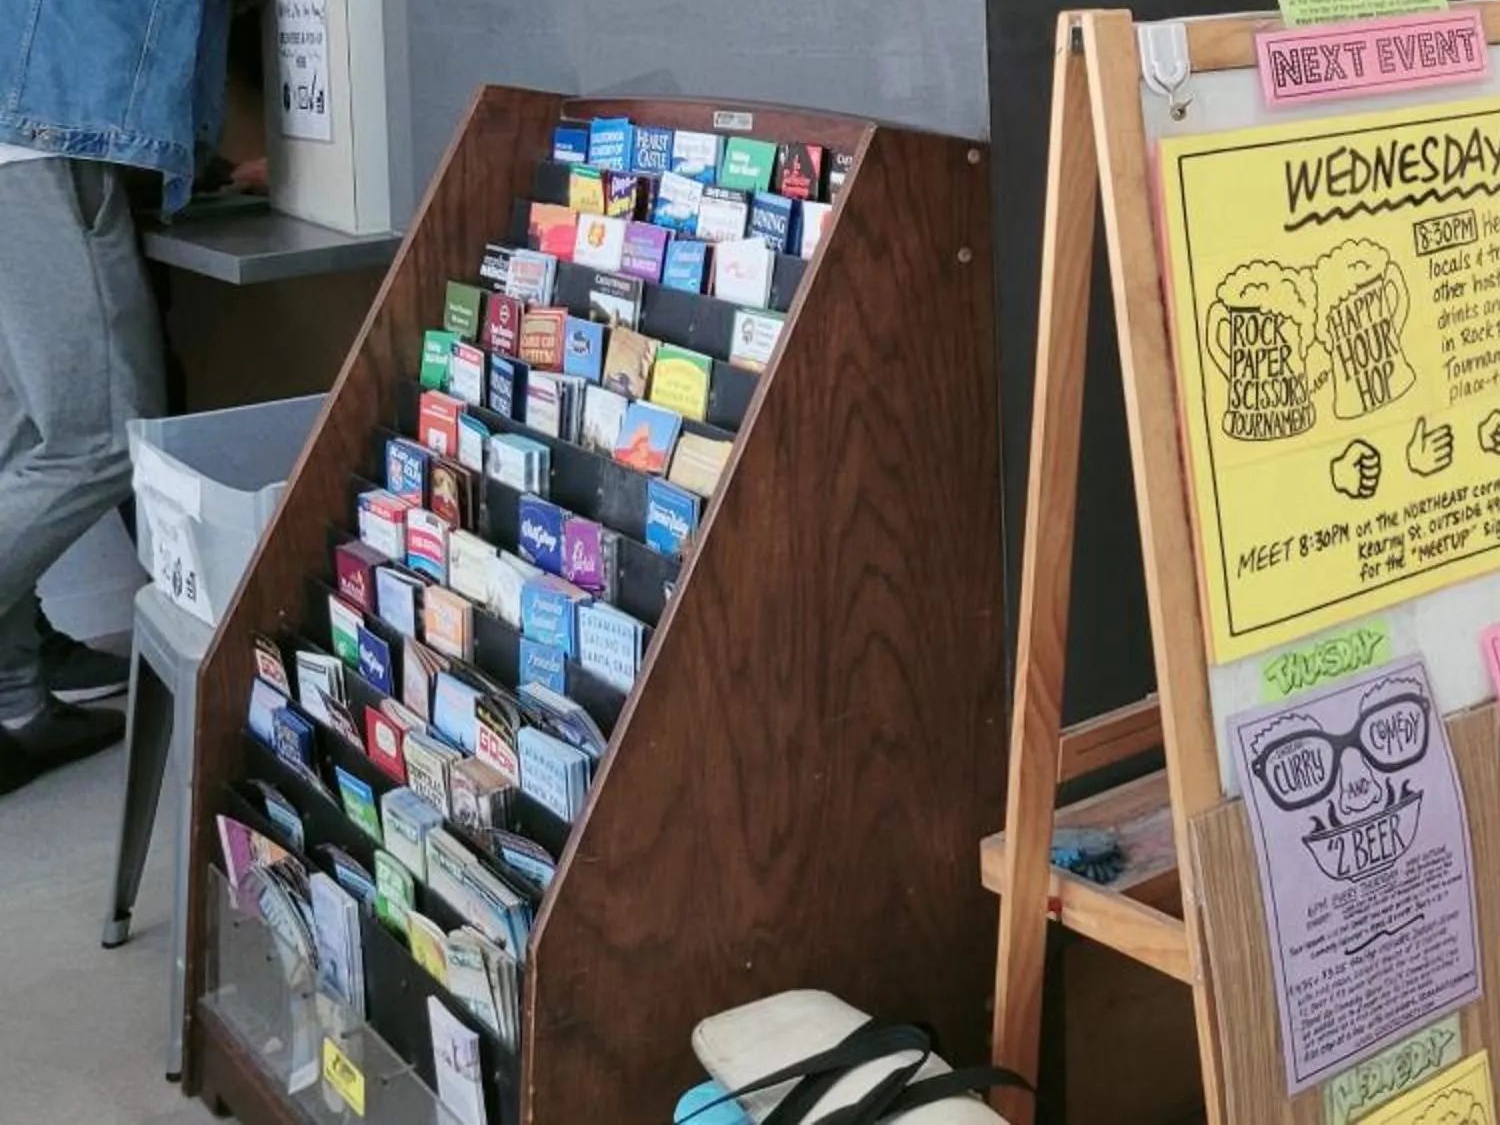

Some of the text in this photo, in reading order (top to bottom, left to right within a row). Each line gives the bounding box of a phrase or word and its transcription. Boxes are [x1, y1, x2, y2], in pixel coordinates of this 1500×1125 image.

[1271, 26, 1479, 89] NEXT EVENT
[1417, 216, 1475, 252] 8:30PM
[1429, 250, 1471, 279] locals
[1432, 279, 1467, 304] other
[1232, 314, 1288, 348] ROCK
[1329, 285, 1385, 343] HAPPY
[1437, 303, 1480, 330] drinks
[1336, 318, 1399, 383] HOUR
[1441, 336, 1456, 354] in
[1461, 321, 1495, 346] Rock
[1232, 344, 1296, 381] PAPER
[1231, 375, 1310, 412] SCISSORS
[1355, 360, 1395, 413] HOP
[1226, 404, 1313, 438] TOURNAMENT
[1237, 535, 1295, 579] MEET
[1299, 522, 1351, 559] 8:30PM
[1356, 519, 1373, 539] on
[1403, 485, 1469, 524] NORTHEAST
[1357, 531, 1406, 562] Kearny
[1428, 502, 1482, 535] OUTSIDE
[1359, 562, 1382, 583] for
[1385, 553, 1406, 573] the
[1265, 625, 1388, 697] THURSDAY
[1369, 710, 1421, 756] COMEDY
[1273, 748, 1326, 796] CURRY
[1351, 812, 1407, 873] BEER
